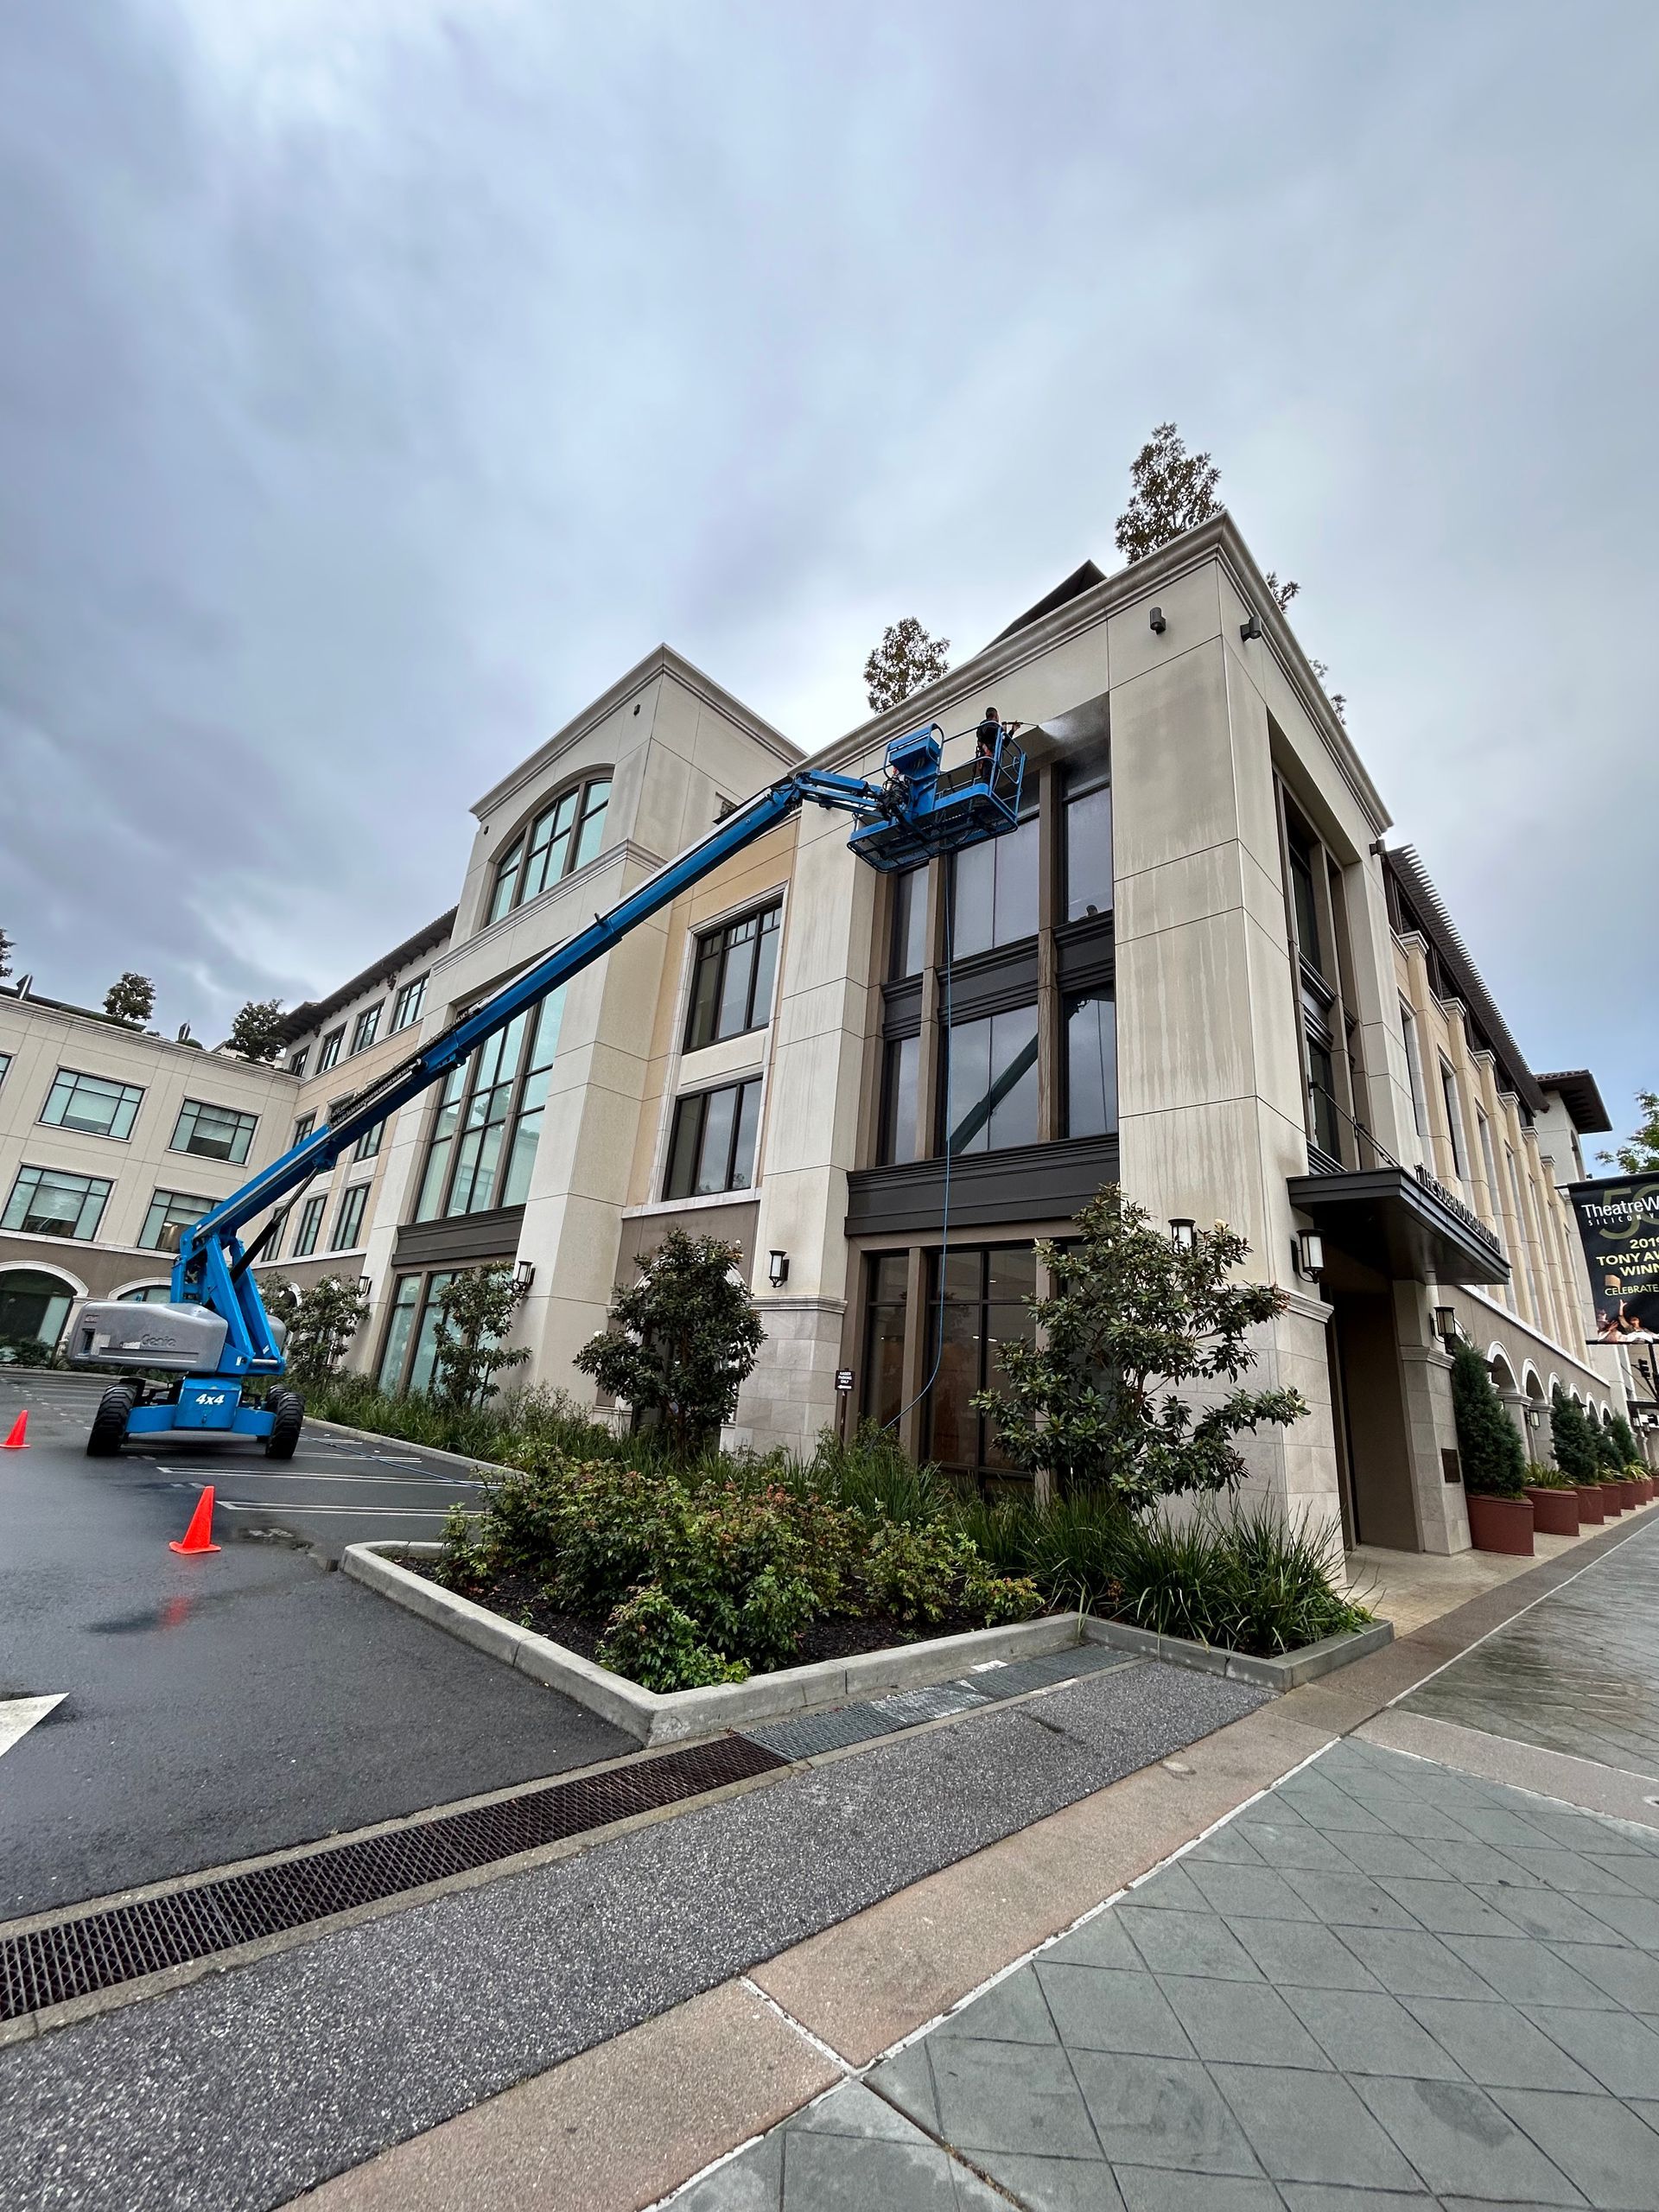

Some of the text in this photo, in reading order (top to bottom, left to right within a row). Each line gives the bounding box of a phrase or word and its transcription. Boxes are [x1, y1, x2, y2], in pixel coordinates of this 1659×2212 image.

[1588, 1214, 1642, 1226] SILICON
[1596, 1252, 1641, 1267] TONY
[1605, 1284, 1659, 1296] CELEBRATE
[141, 1334, 176, 1347] Genie
[195, 1393, 225, 1405] 4x4
